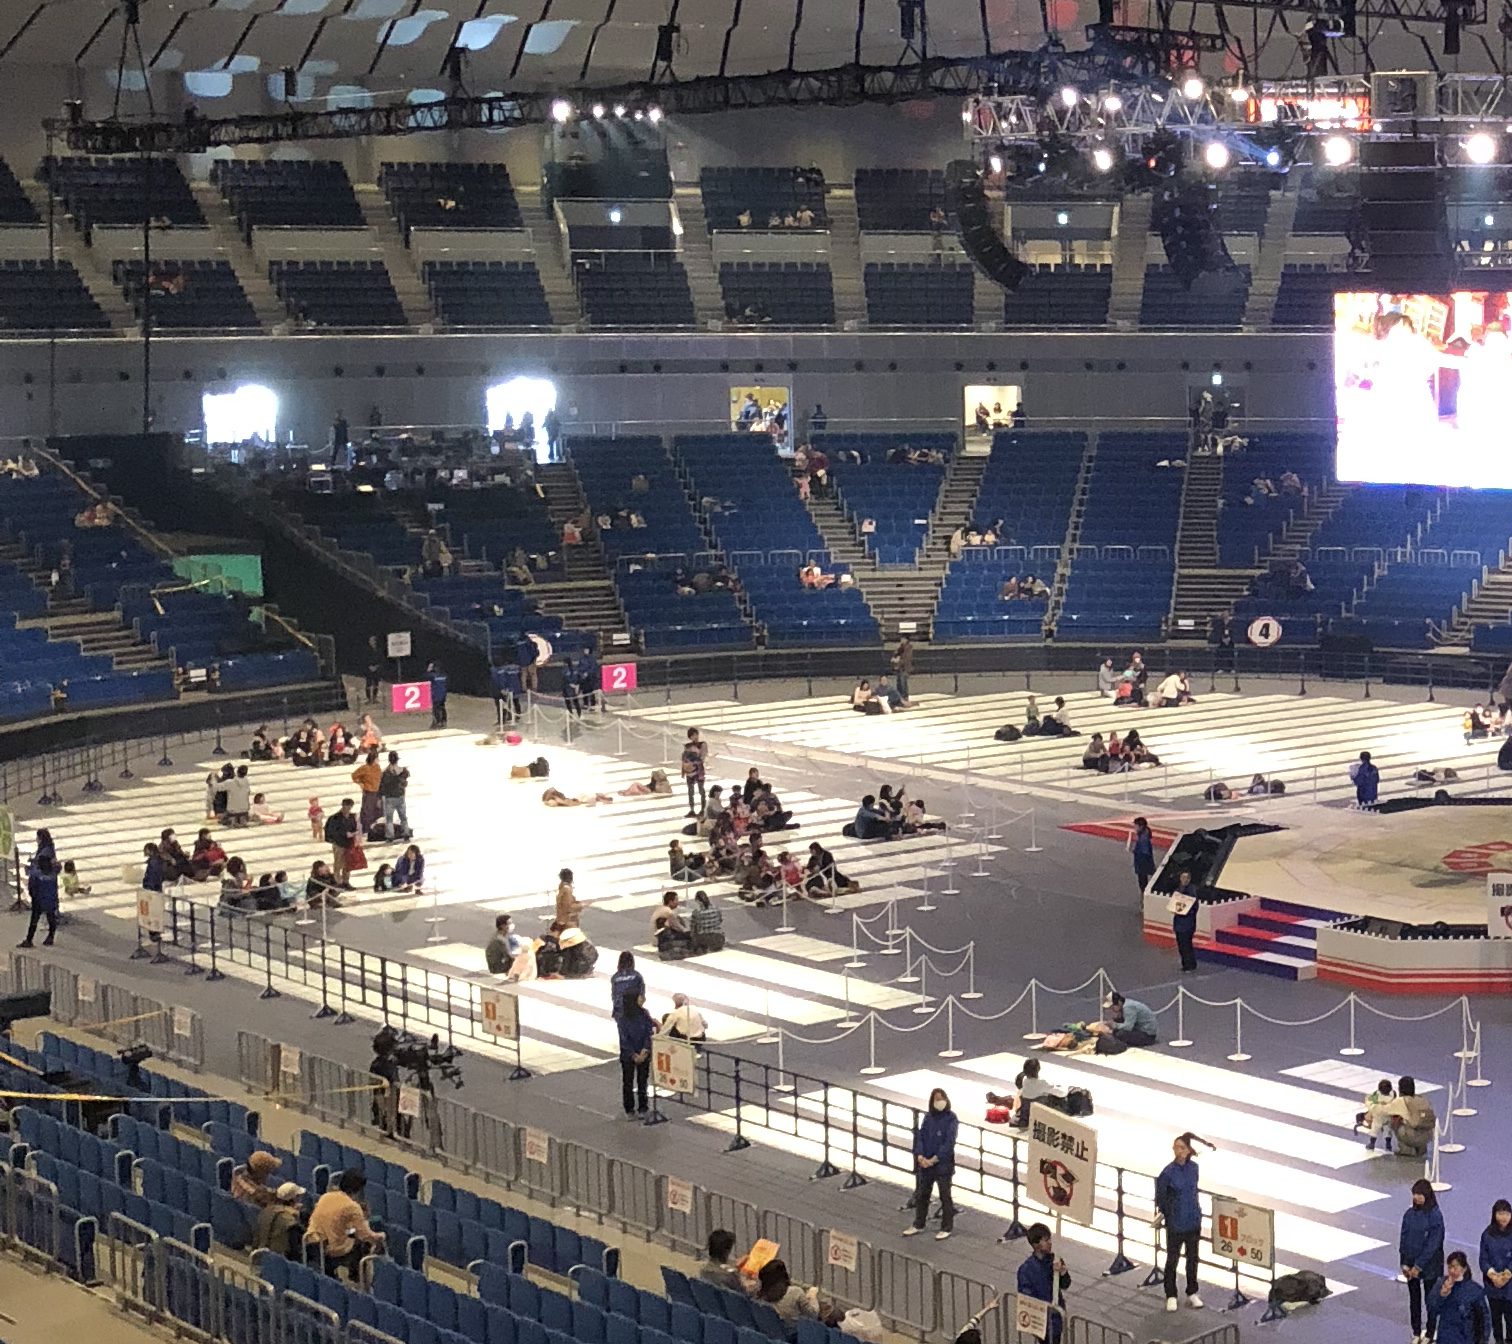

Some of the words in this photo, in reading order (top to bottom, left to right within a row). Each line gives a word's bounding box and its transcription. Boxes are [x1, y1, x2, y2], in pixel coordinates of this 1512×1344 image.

[1258, 622, 1270, 640] 4
[613, 666, 628, 690] 2
[404, 686, 421, 709] 2
[1032, 1119, 1089, 1163] 撮影禁止
[1220, 1239, 1233, 1254] 26
[1250, 1247, 1263, 1262] 50
